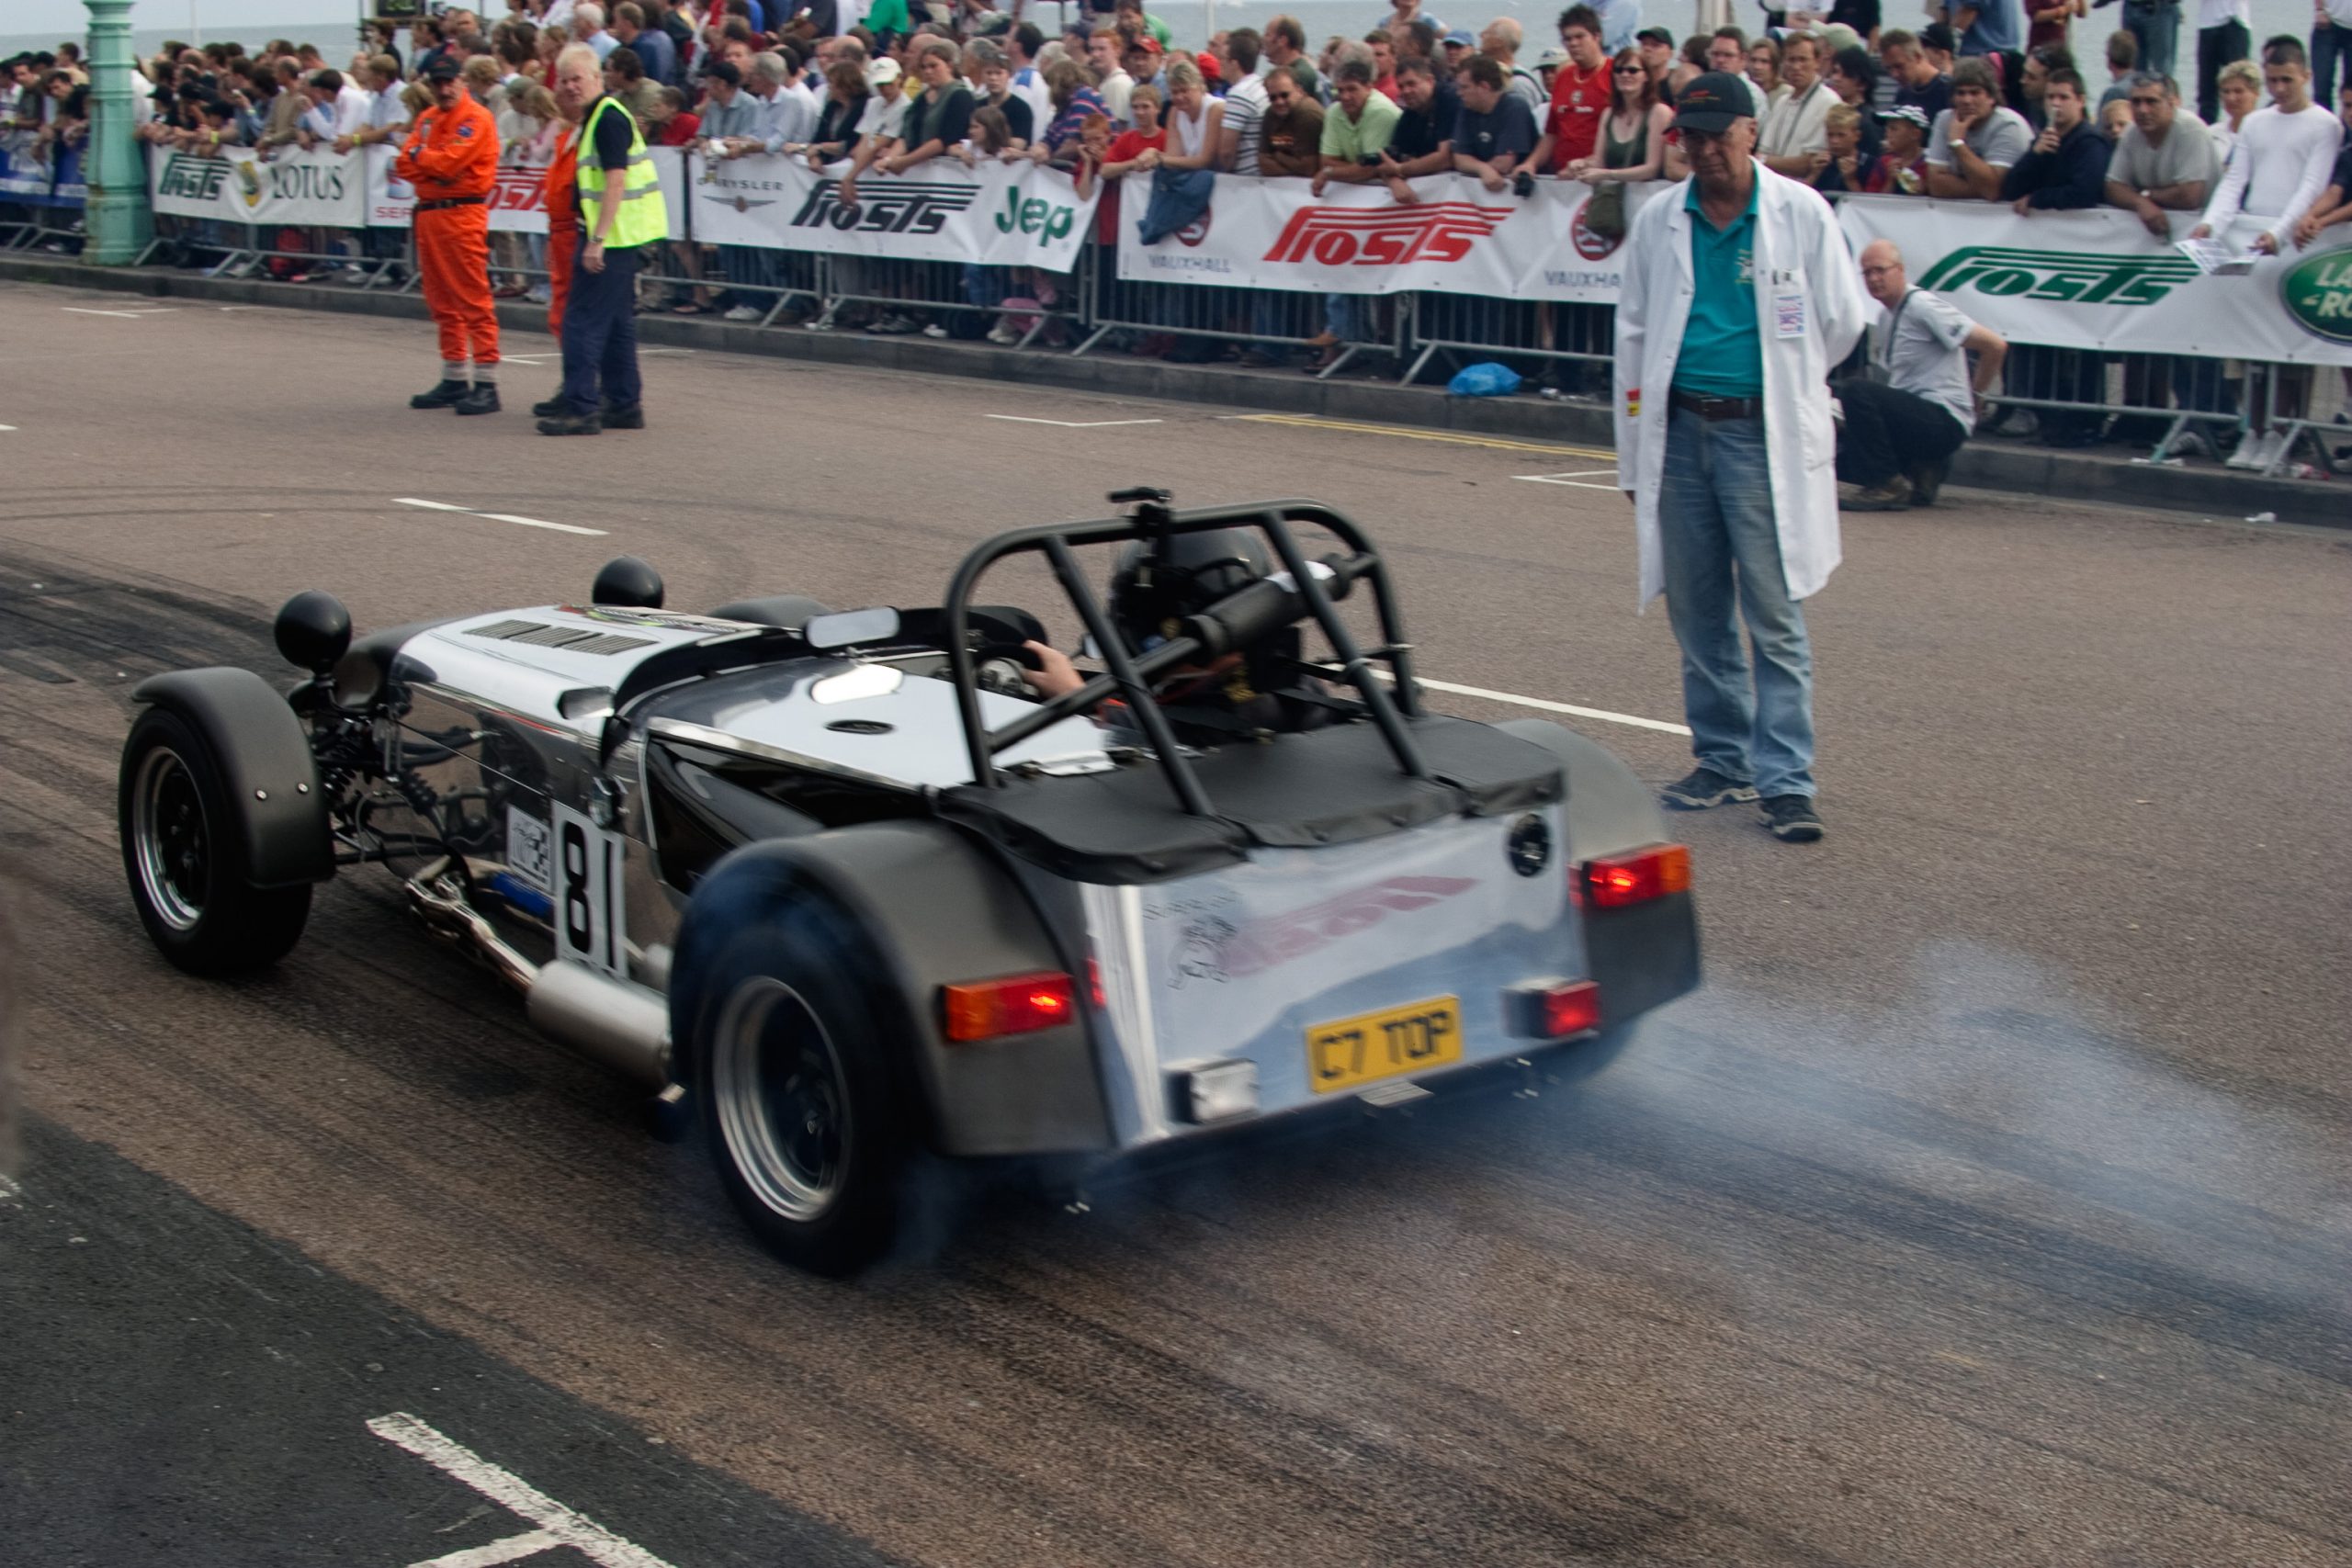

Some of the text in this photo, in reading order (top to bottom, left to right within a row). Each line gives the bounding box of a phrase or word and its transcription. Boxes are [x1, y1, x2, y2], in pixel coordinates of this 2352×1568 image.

[270, 165, 345, 200] LOTUS
[696, 177, 785, 191] CRYSLER
[995, 186, 1074, 247] Jep
[1544, 271, 1622, 288] VAUXHA
[563, 819, 617, 970] 81
[1312, 1010, 1453, 1080] C7 TOP
